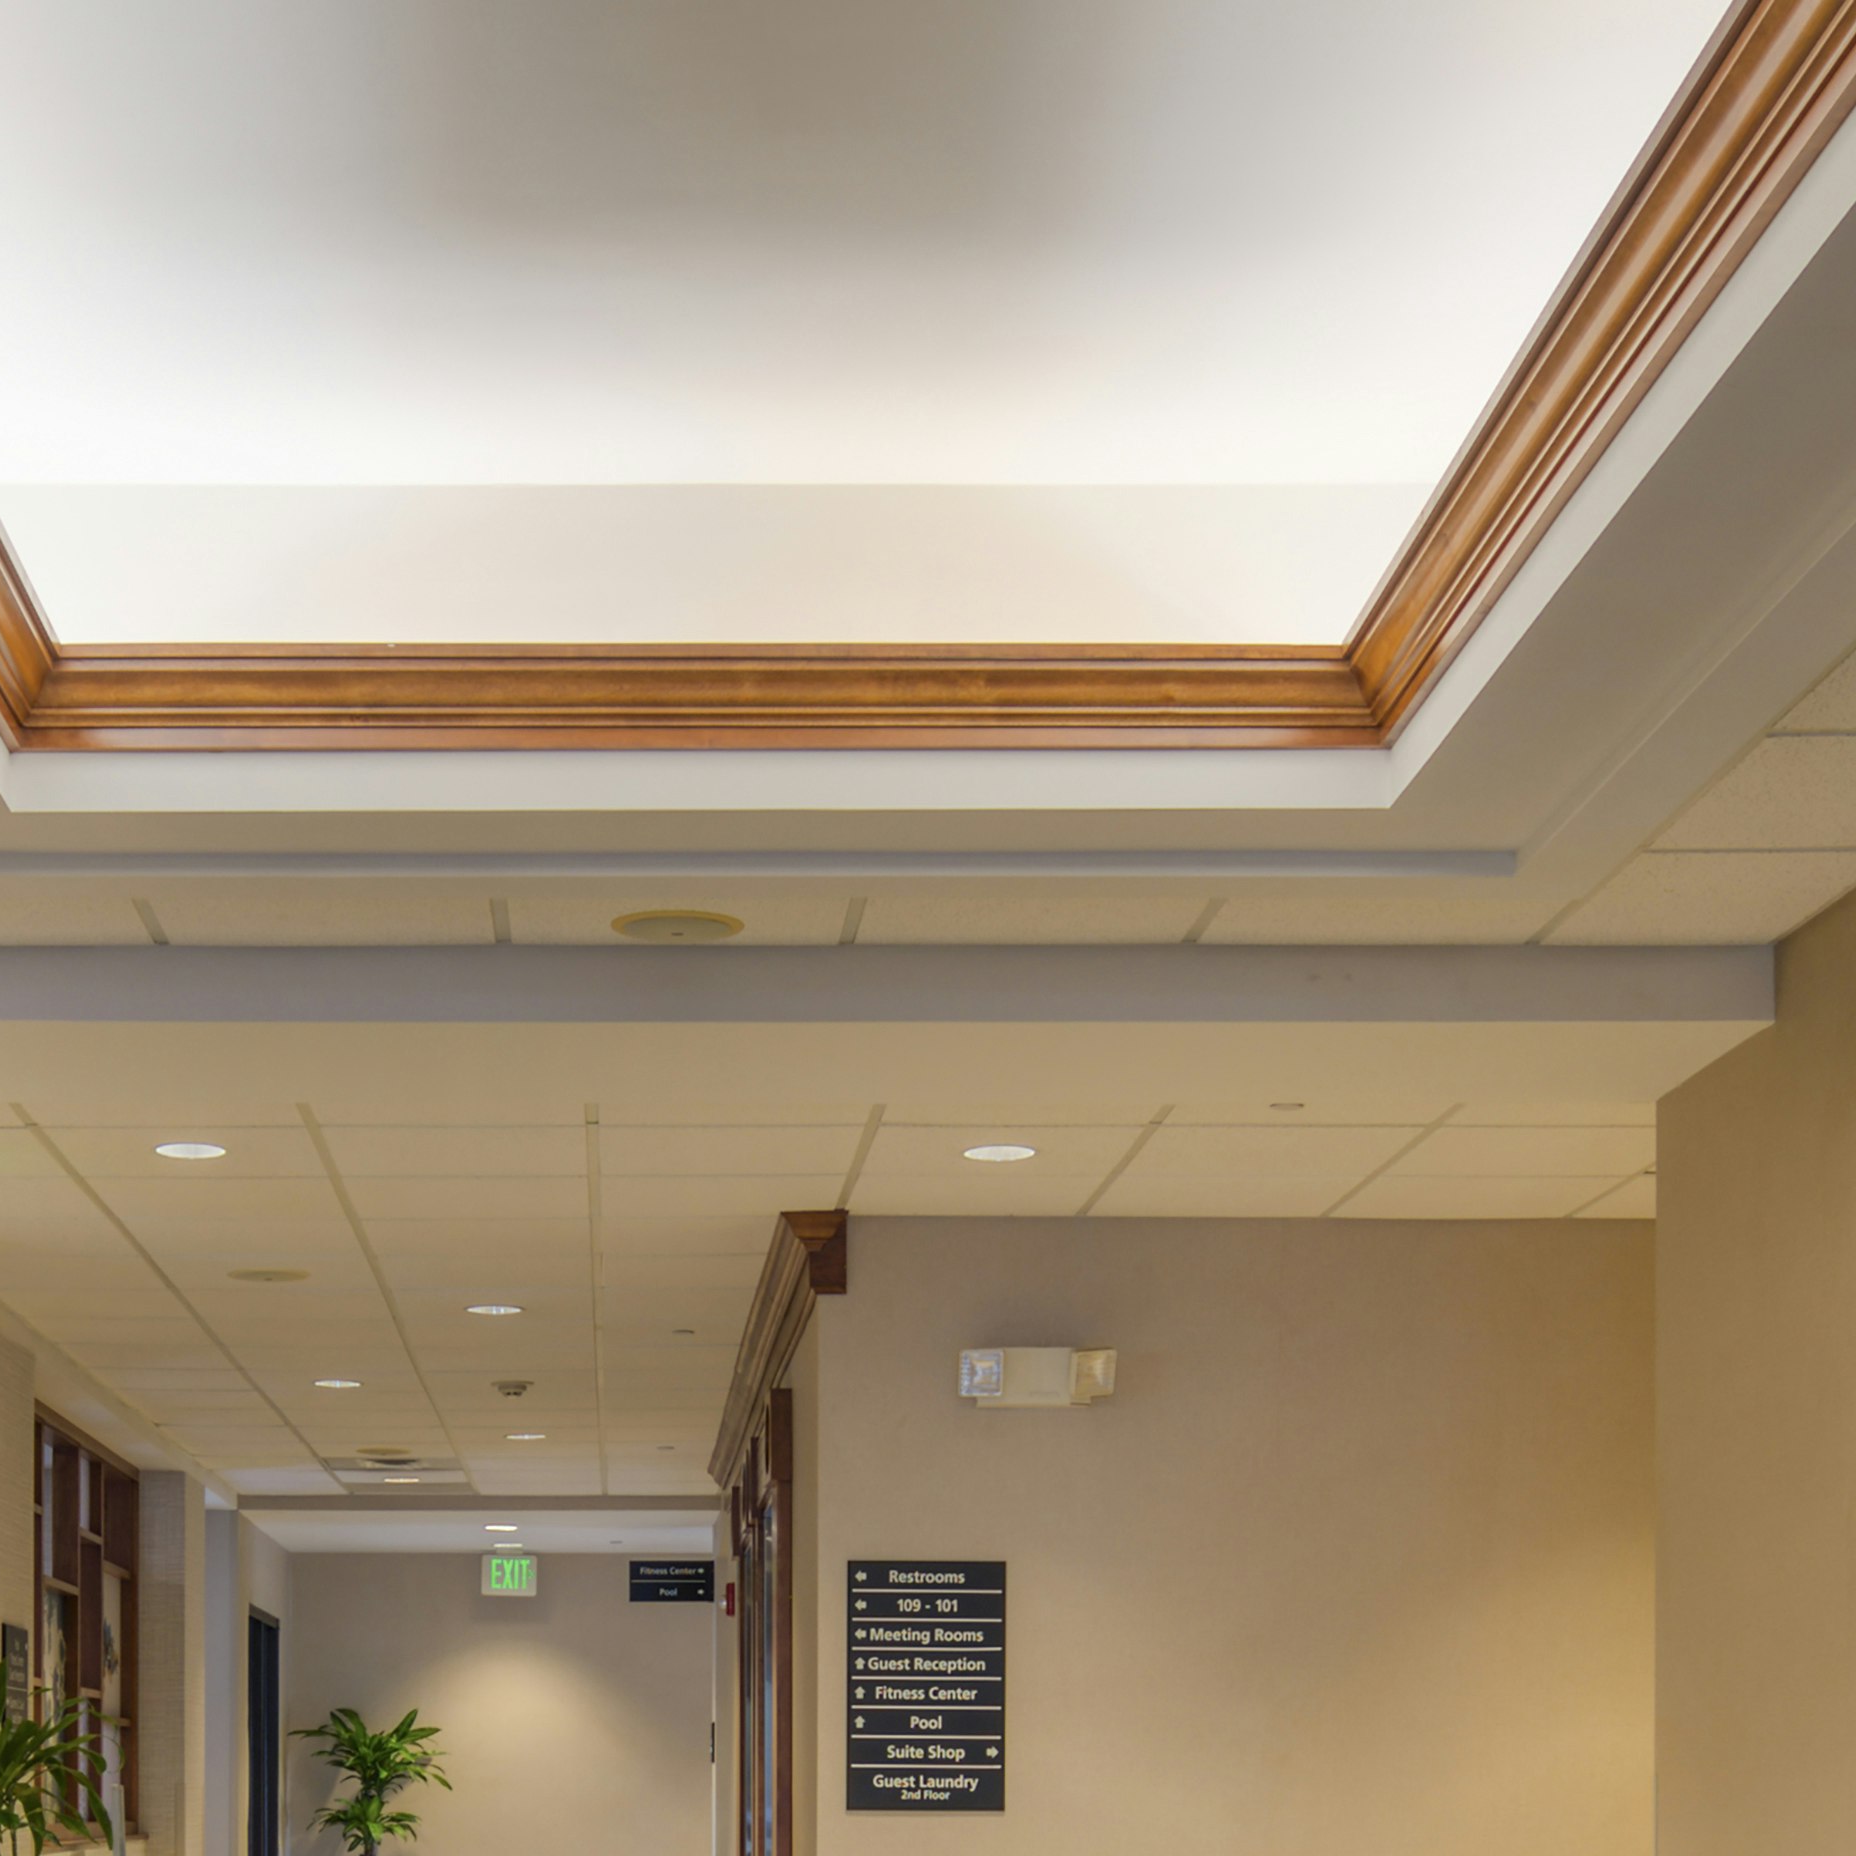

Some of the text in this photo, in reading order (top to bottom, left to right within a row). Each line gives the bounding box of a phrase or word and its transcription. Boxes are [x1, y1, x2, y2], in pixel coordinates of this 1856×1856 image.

[491, 1559, 530, 1589] EXIT
[640, 1567, 697, 1575] Fitness Center
[889, 1570, 965, 1584] Restrooms
[659, 1588, 678, 1597] Pool
[897, 1599, 921, 1612] 109
[935, 1600, 958, 1612] 101
[869, 1628, 984, 1644] Meeting Rooms
[868, 1657, 986, 1674] Guest Reception
[875, 1686, 978, 1700] Fitness Center
[910, 1716, 943, 1730] Pool
[887, 1745, 965, 1762] Suite Shop
[873, 1774, 979, 1792] Guest Laundry
[901, 1790, 950, 1800] 2nd Floor
